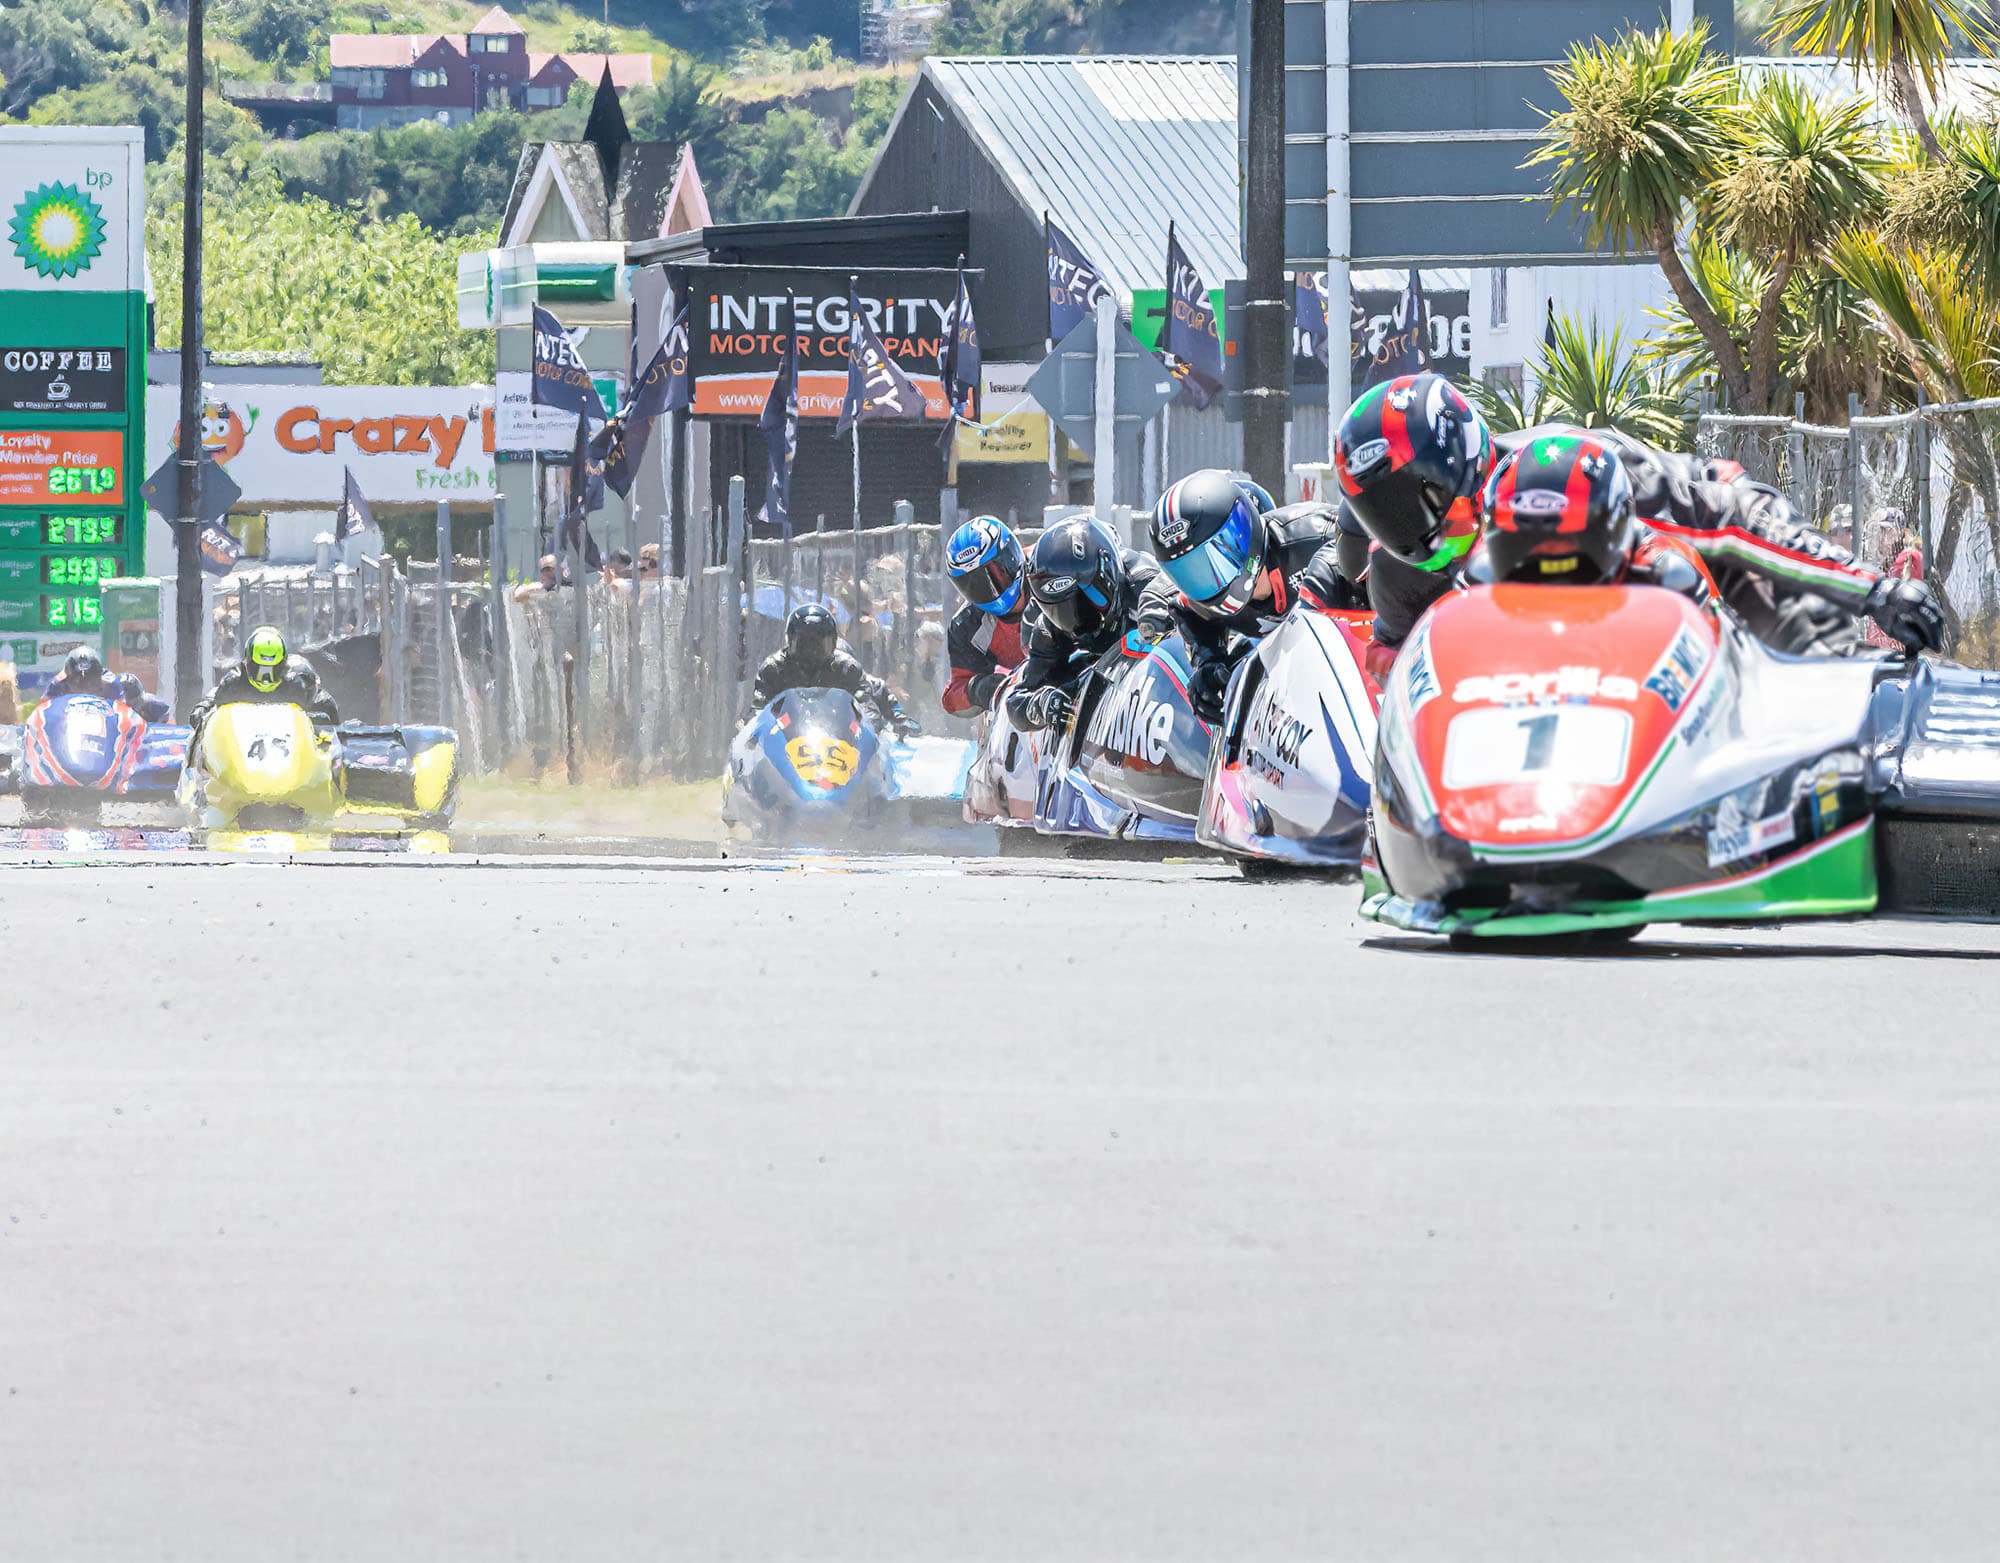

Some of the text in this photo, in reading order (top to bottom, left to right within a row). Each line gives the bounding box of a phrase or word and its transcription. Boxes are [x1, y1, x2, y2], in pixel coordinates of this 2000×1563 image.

[86, 167, 113, 191] bp
[709, 333, 810, 357] MOTOR
[4, 351, 112, 372] COFFEE
[0, 433, 51, 450] Loyalty
[274, 405, 467, 469] Crazy
[0, 450, 97, 465] Member Price
[415, 466, 480, 489] Fresh
[1452, 666, 1639, 703] aprilia
[1517, 714, 1559, 771] 1
